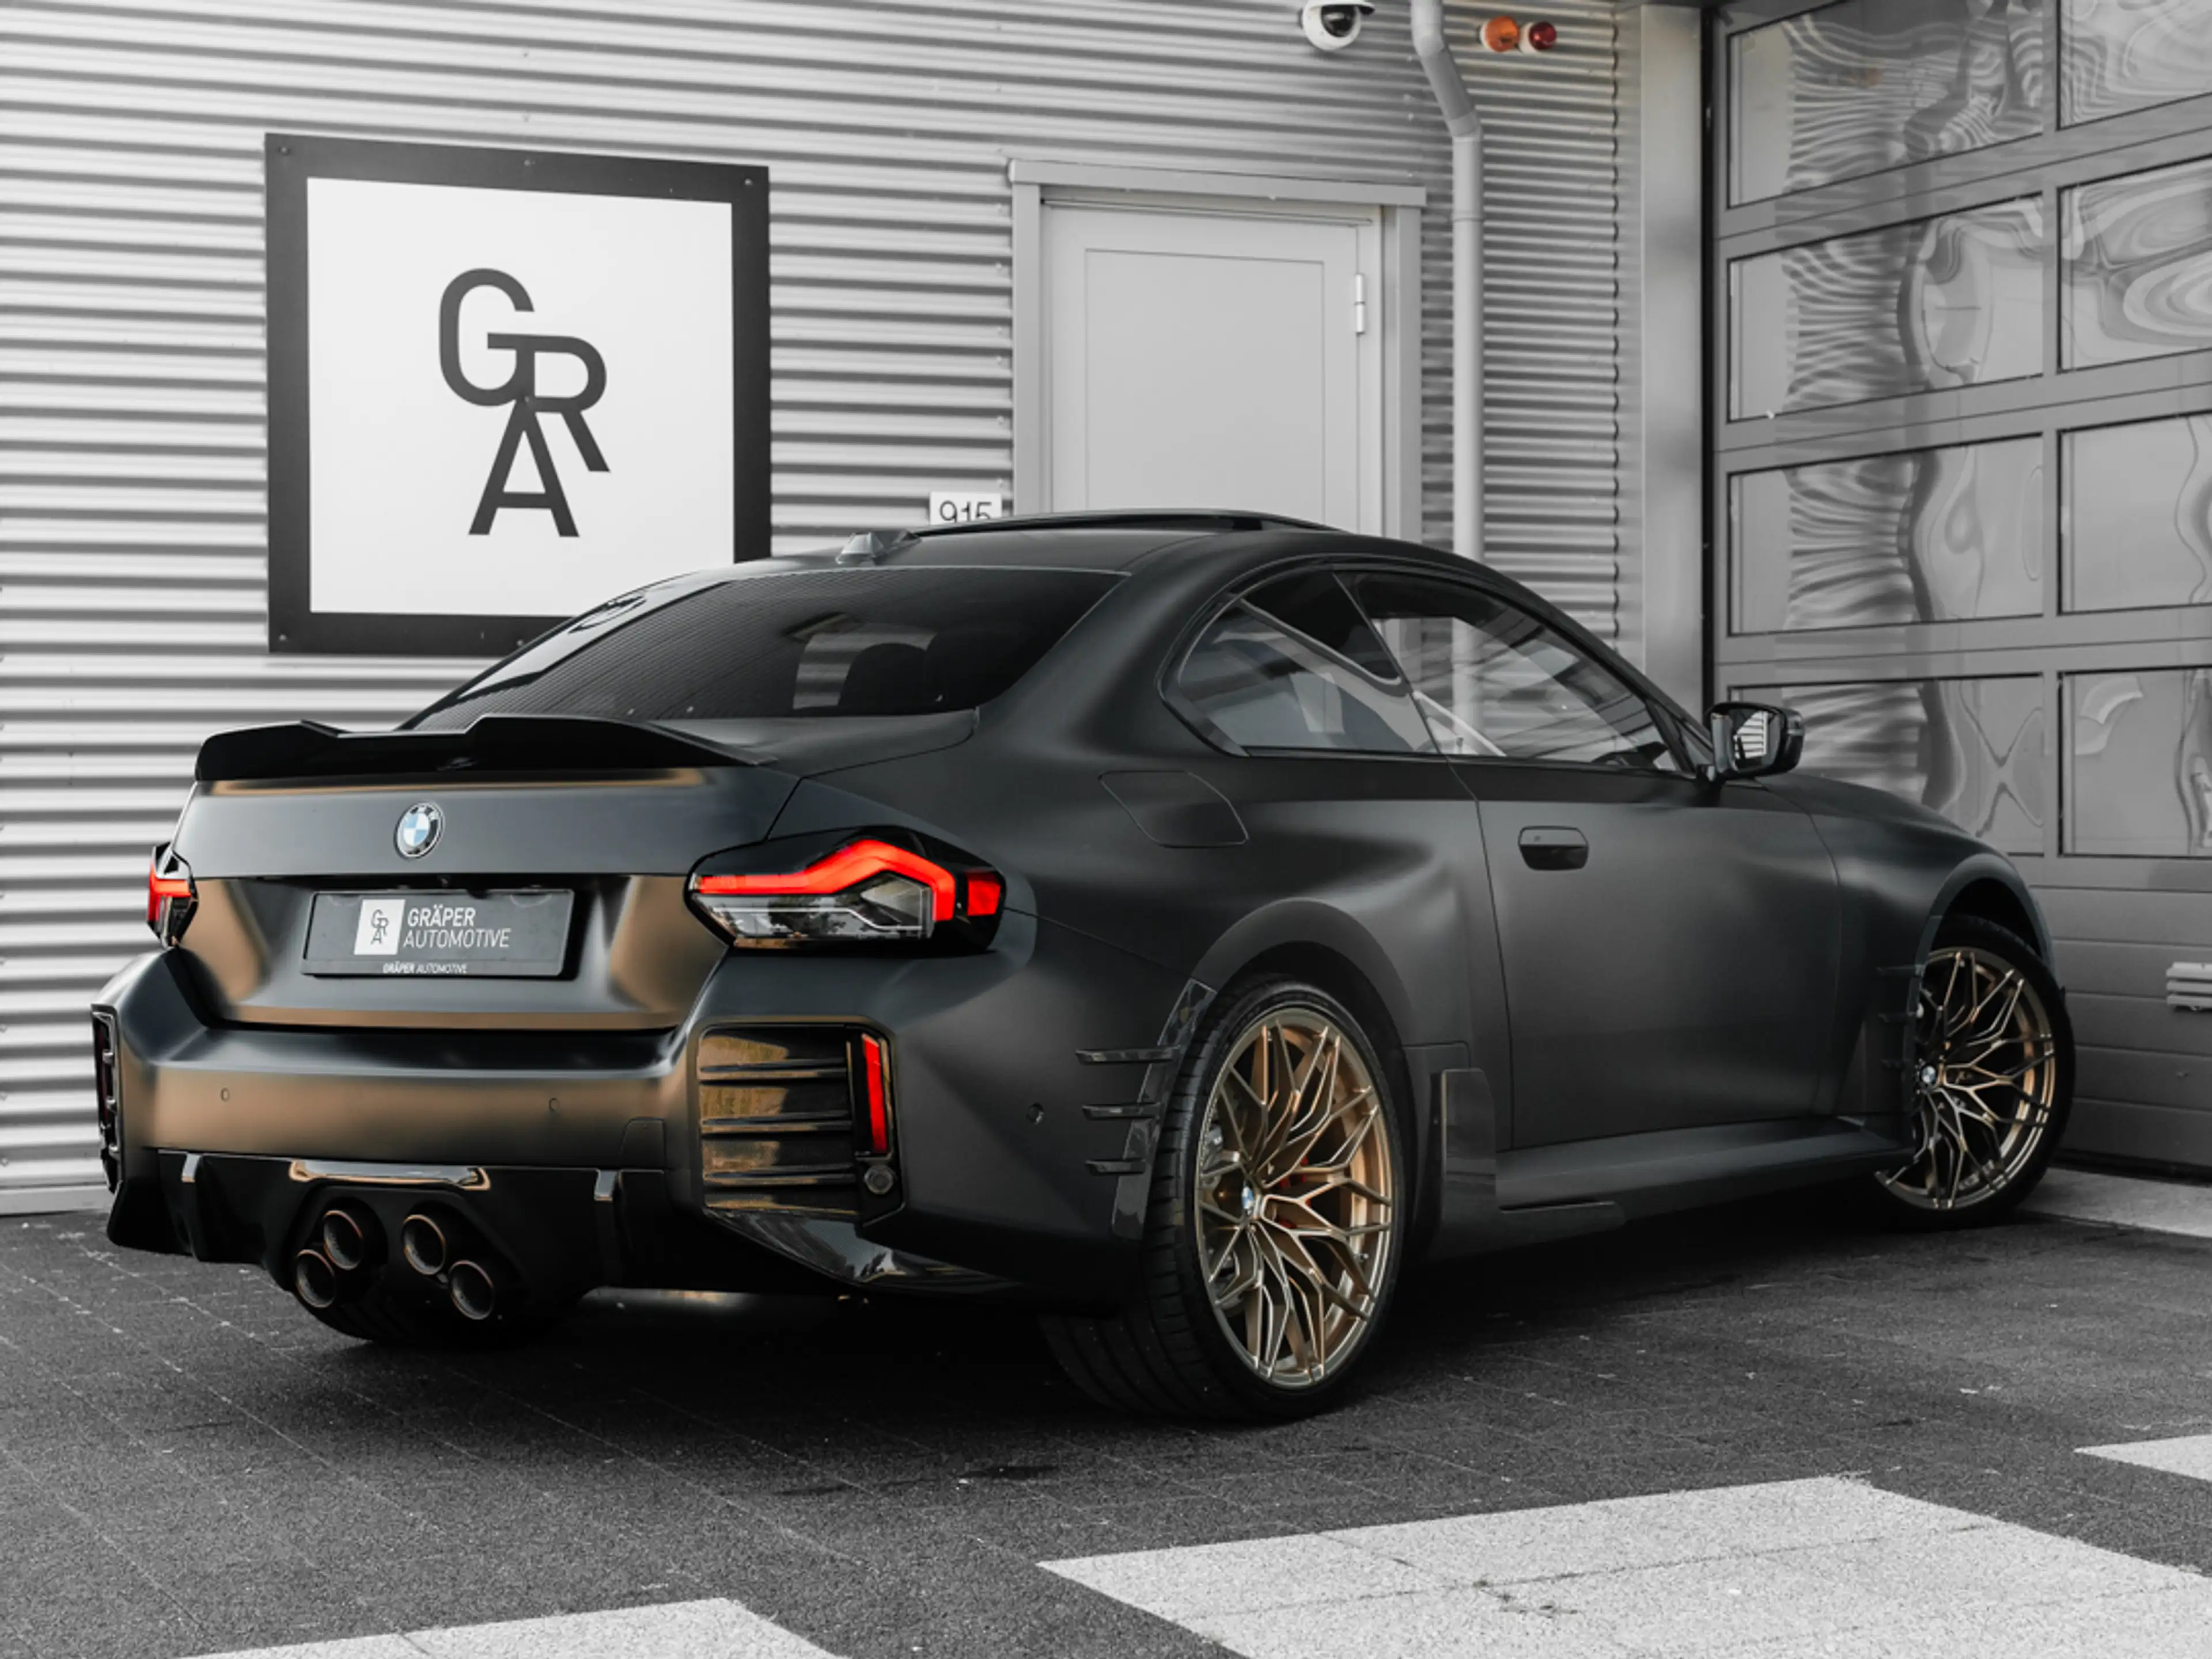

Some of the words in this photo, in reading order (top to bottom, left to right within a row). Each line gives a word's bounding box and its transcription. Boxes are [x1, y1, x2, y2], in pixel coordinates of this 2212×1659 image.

[408, 904, 476, 927] GRÄPER
[403, 928, 512, 948] AUTOMOTIVE
[382, 961, 415, 974] GRÄPER
[416, 963, 467, 974] AUTOMOTIVE
